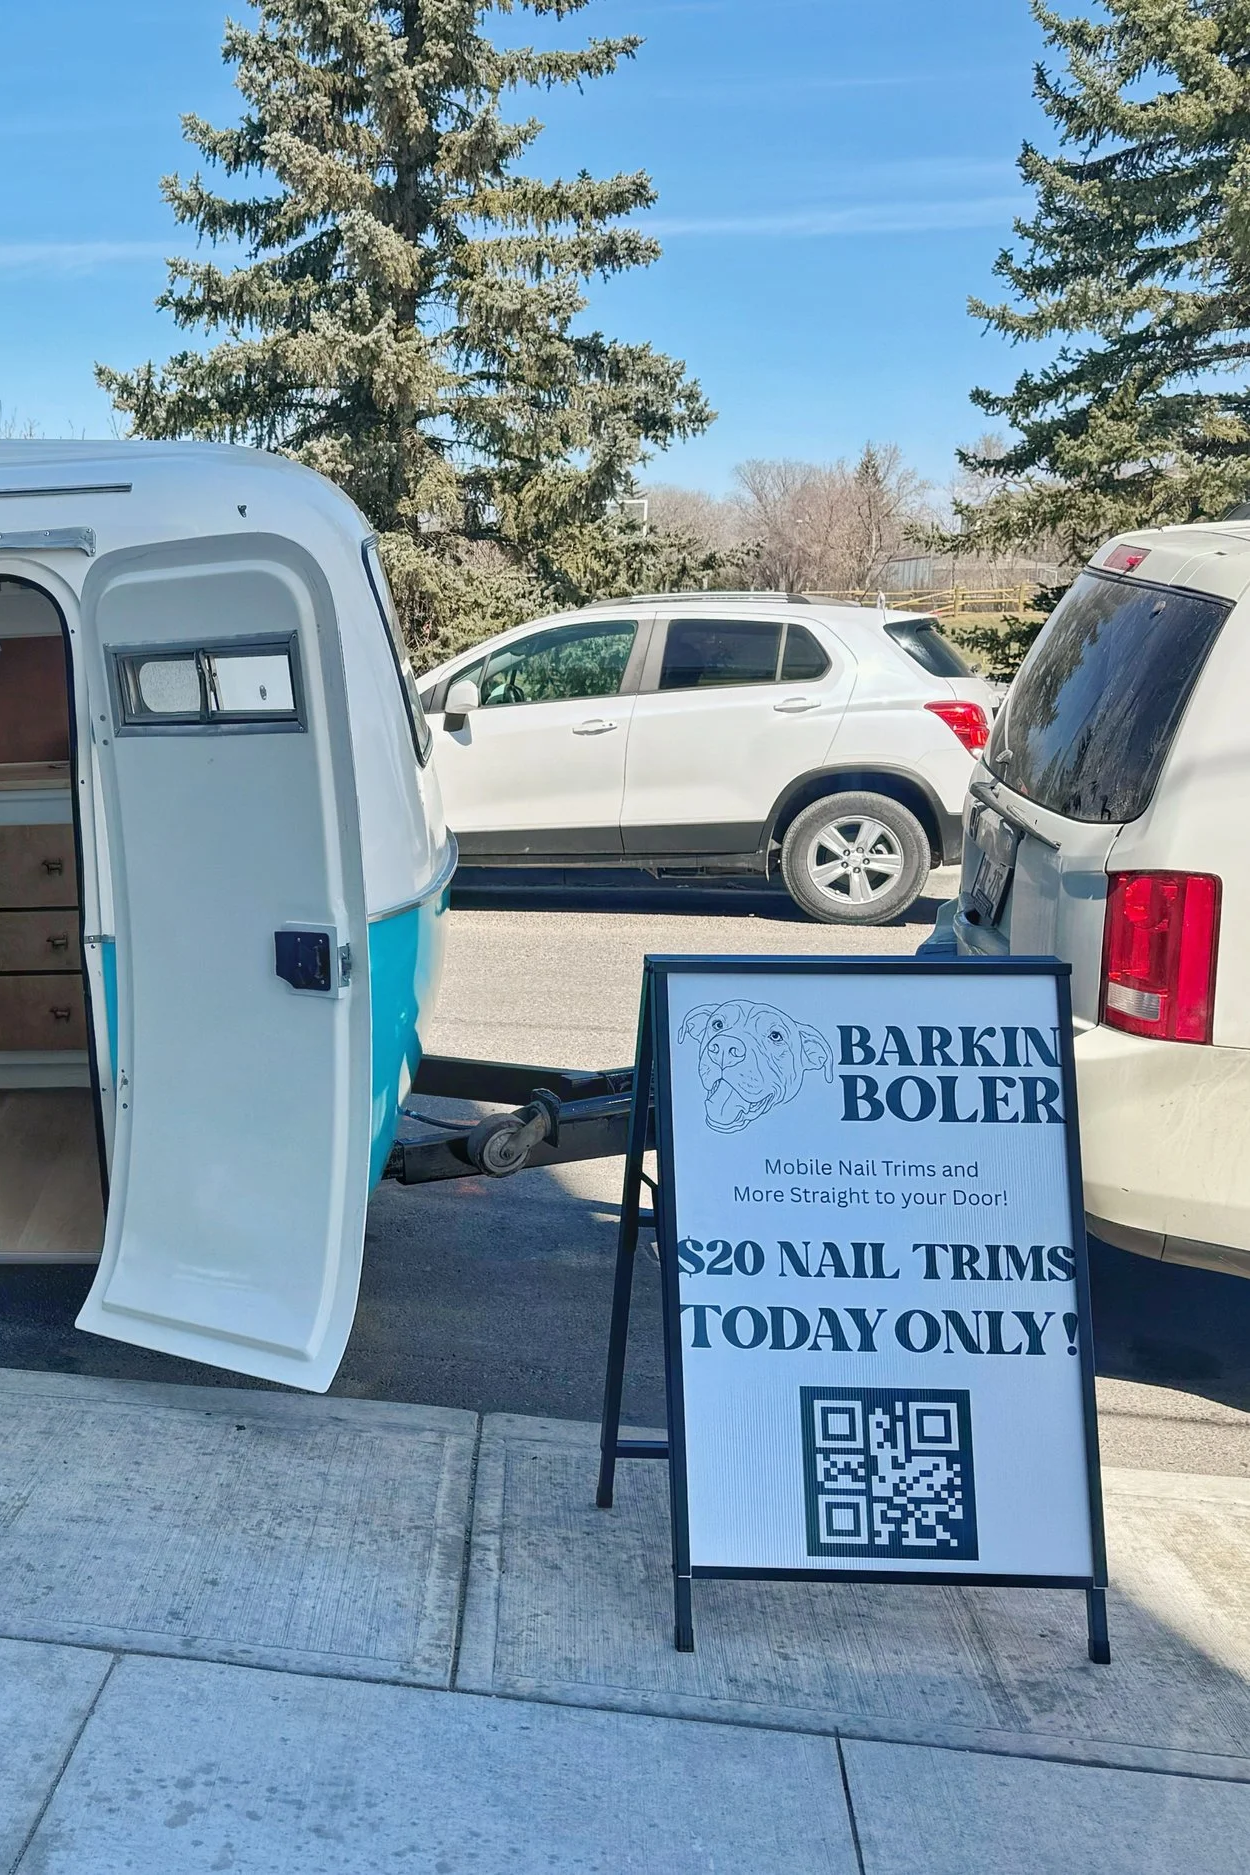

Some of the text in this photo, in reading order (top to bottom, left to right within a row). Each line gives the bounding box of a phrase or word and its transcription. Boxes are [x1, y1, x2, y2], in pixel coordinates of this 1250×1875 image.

[836, 1024, 1063, 1068] BARKIN
[838, 1074, 1068, 1124] BOLER
[764, 1158, 979, 1178] Mobile Nail Trims and
[733, 1185, 1008, 1209] More Straight to your Door!
[677, 1235, 1077, 1282] $20 NAIL TRIMS
[680, 1303, 1079, 1357] TODAY ONLY!
